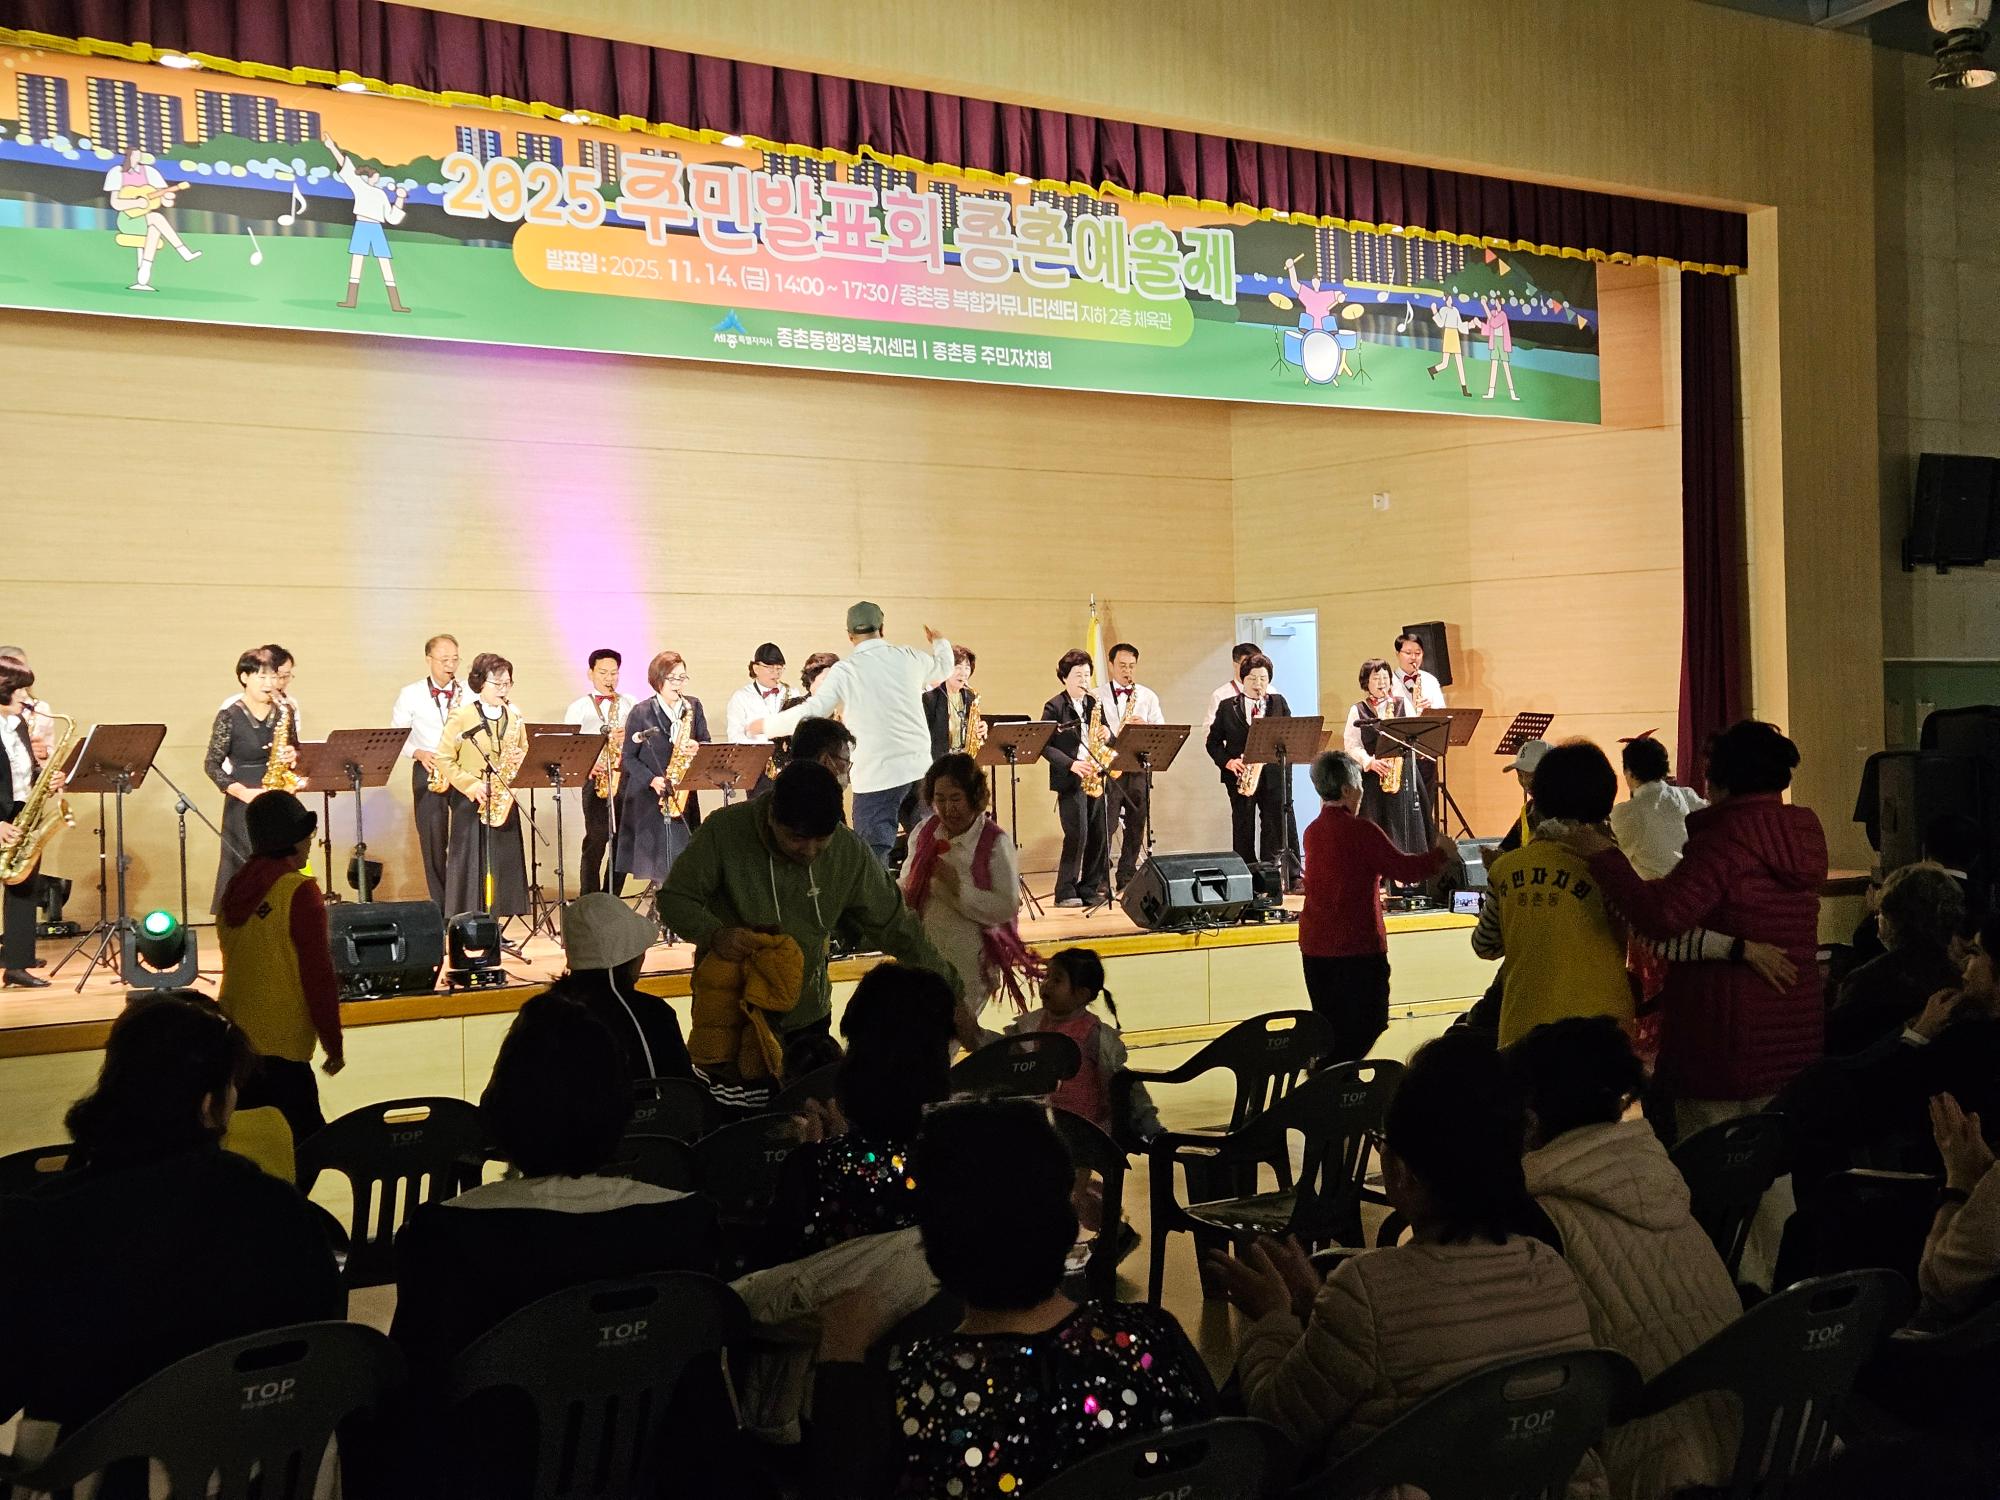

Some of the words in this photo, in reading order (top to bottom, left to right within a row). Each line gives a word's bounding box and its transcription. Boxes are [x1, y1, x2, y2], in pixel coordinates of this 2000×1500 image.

[441, 152, 607, 229] 2025
[616, 153, 944, 273] 주민발표회
[955, 197, 1236, 304] 종촌예술제
[668, 258, 701, 284] 11.
[740, 265, 770, 293] (금)
[775, 273, 824, 297] 14:00
[900, 284, 950, 310] 종촌동
[953, 288, 1078, 323] 복합커뮤니티센터
[1081, 304, 1108, 325] 지하
[1110, 307, 1132, 327] 2층
[1134, 310, 1172, 330] 체육관
[777, 327, 917, 359] 종촌동행정복지센터
[932, 341, 977, 364] 종촌동
[981, 345, 1053, 370] 주민자치회
[1267, 1036, 1290, 1047] TOP
[1011, 1061, 1037, 1073] TOP
[1341, 1091, 1367, 1104] TOP
[392, 1130, 424, 1144] TOP
[599, 1320, 649, 1340] TOP
[1807, 1322, 1844, 1343] TOP
[243, 1378, 296, 1401] TOP
[1507, 1408, 1555, 1431] TOP
